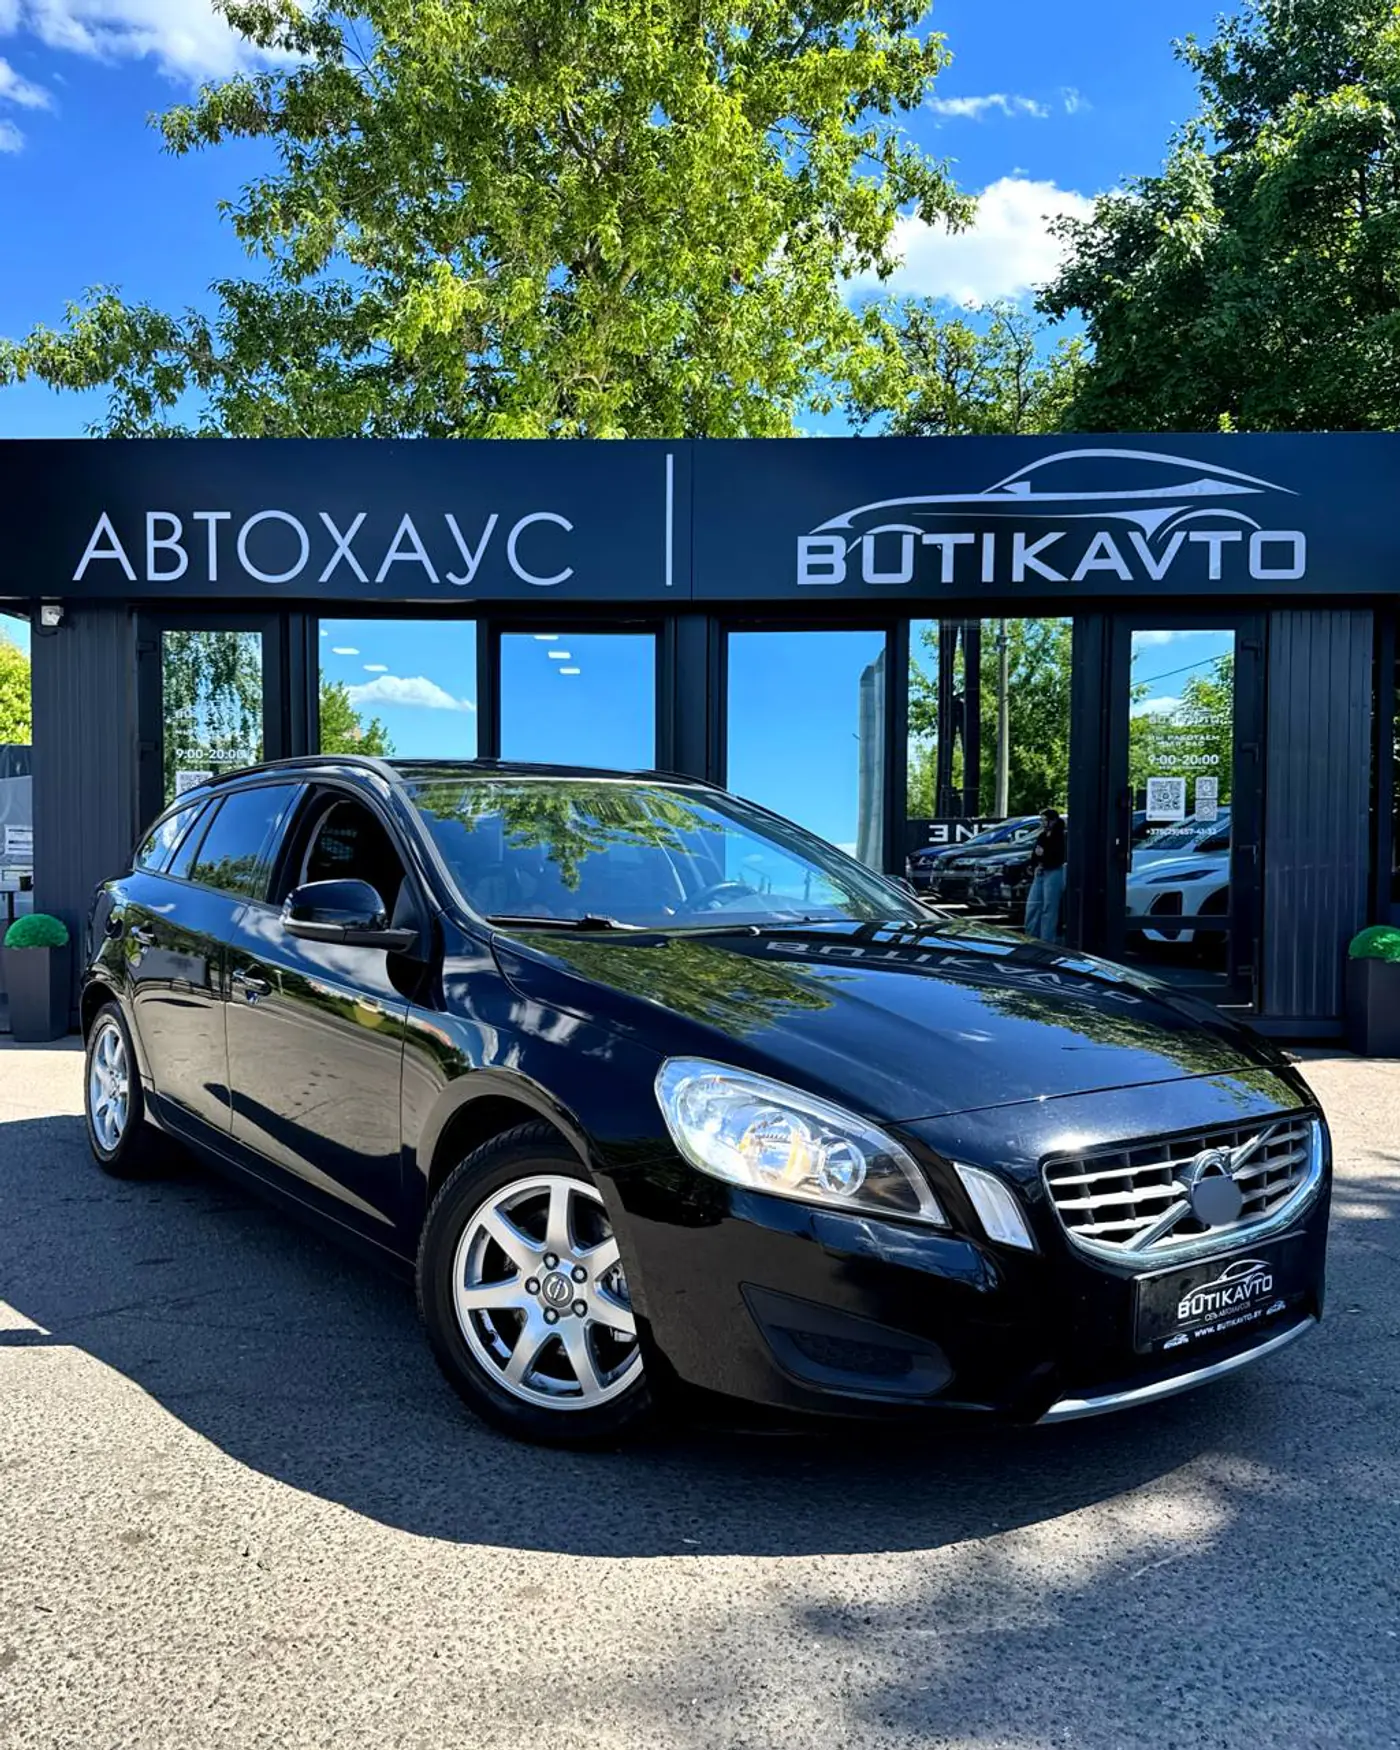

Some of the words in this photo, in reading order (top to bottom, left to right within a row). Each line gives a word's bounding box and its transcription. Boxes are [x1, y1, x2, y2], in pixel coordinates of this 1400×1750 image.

[72, 510, 574, 586] АВТОХАУС
[797, 529, 1306, 586] BUTIKAVTO
[1177, 1274, 1273, 1320] BUTIKAVTO
